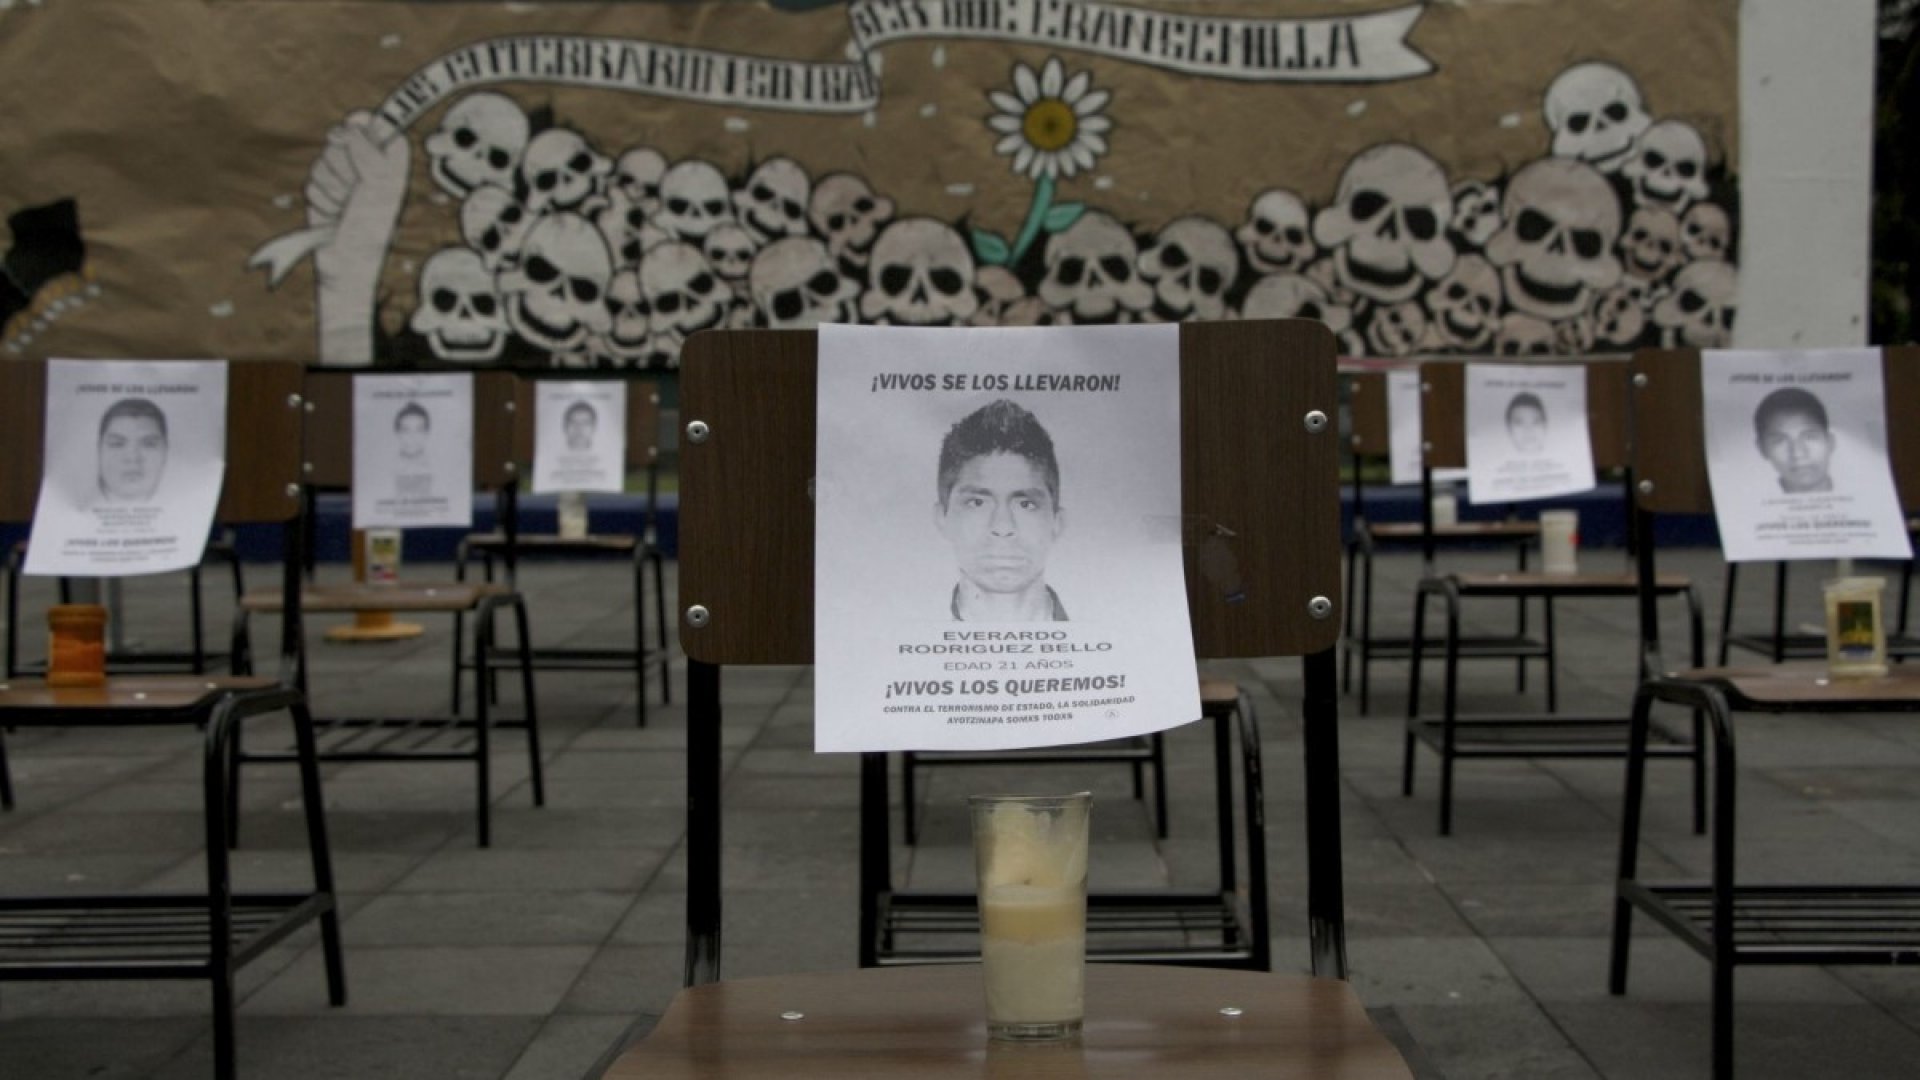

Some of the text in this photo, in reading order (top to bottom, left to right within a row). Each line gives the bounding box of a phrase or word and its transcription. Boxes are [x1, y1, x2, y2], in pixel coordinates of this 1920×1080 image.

[871, 373, 1121, 392] ¡VIVOS SE LOS LLEVARON!
[943, 631, 1068, 641] EVERARDO
[898, 642, 1113, 654] RODRIGUEZ BELLO
[943, 658, 1074, 671] EDAD 21 AÑOS
[885, 674, 1126, 699] ¡VIVOS LOS QUEREMOS!
[882, 705, 921, 713] CONTRA
[923, 704, 935, 713] EL
[937, 703, 1000, 713] TERRORISMO
[1001, 703, 1014, 712] DE
[1057, 700, 1070, 709] LA
[1071, 695, 1136, 708] SOLIDARIDAD
[946, 716, 1004, 725] AYOTZINAPA
